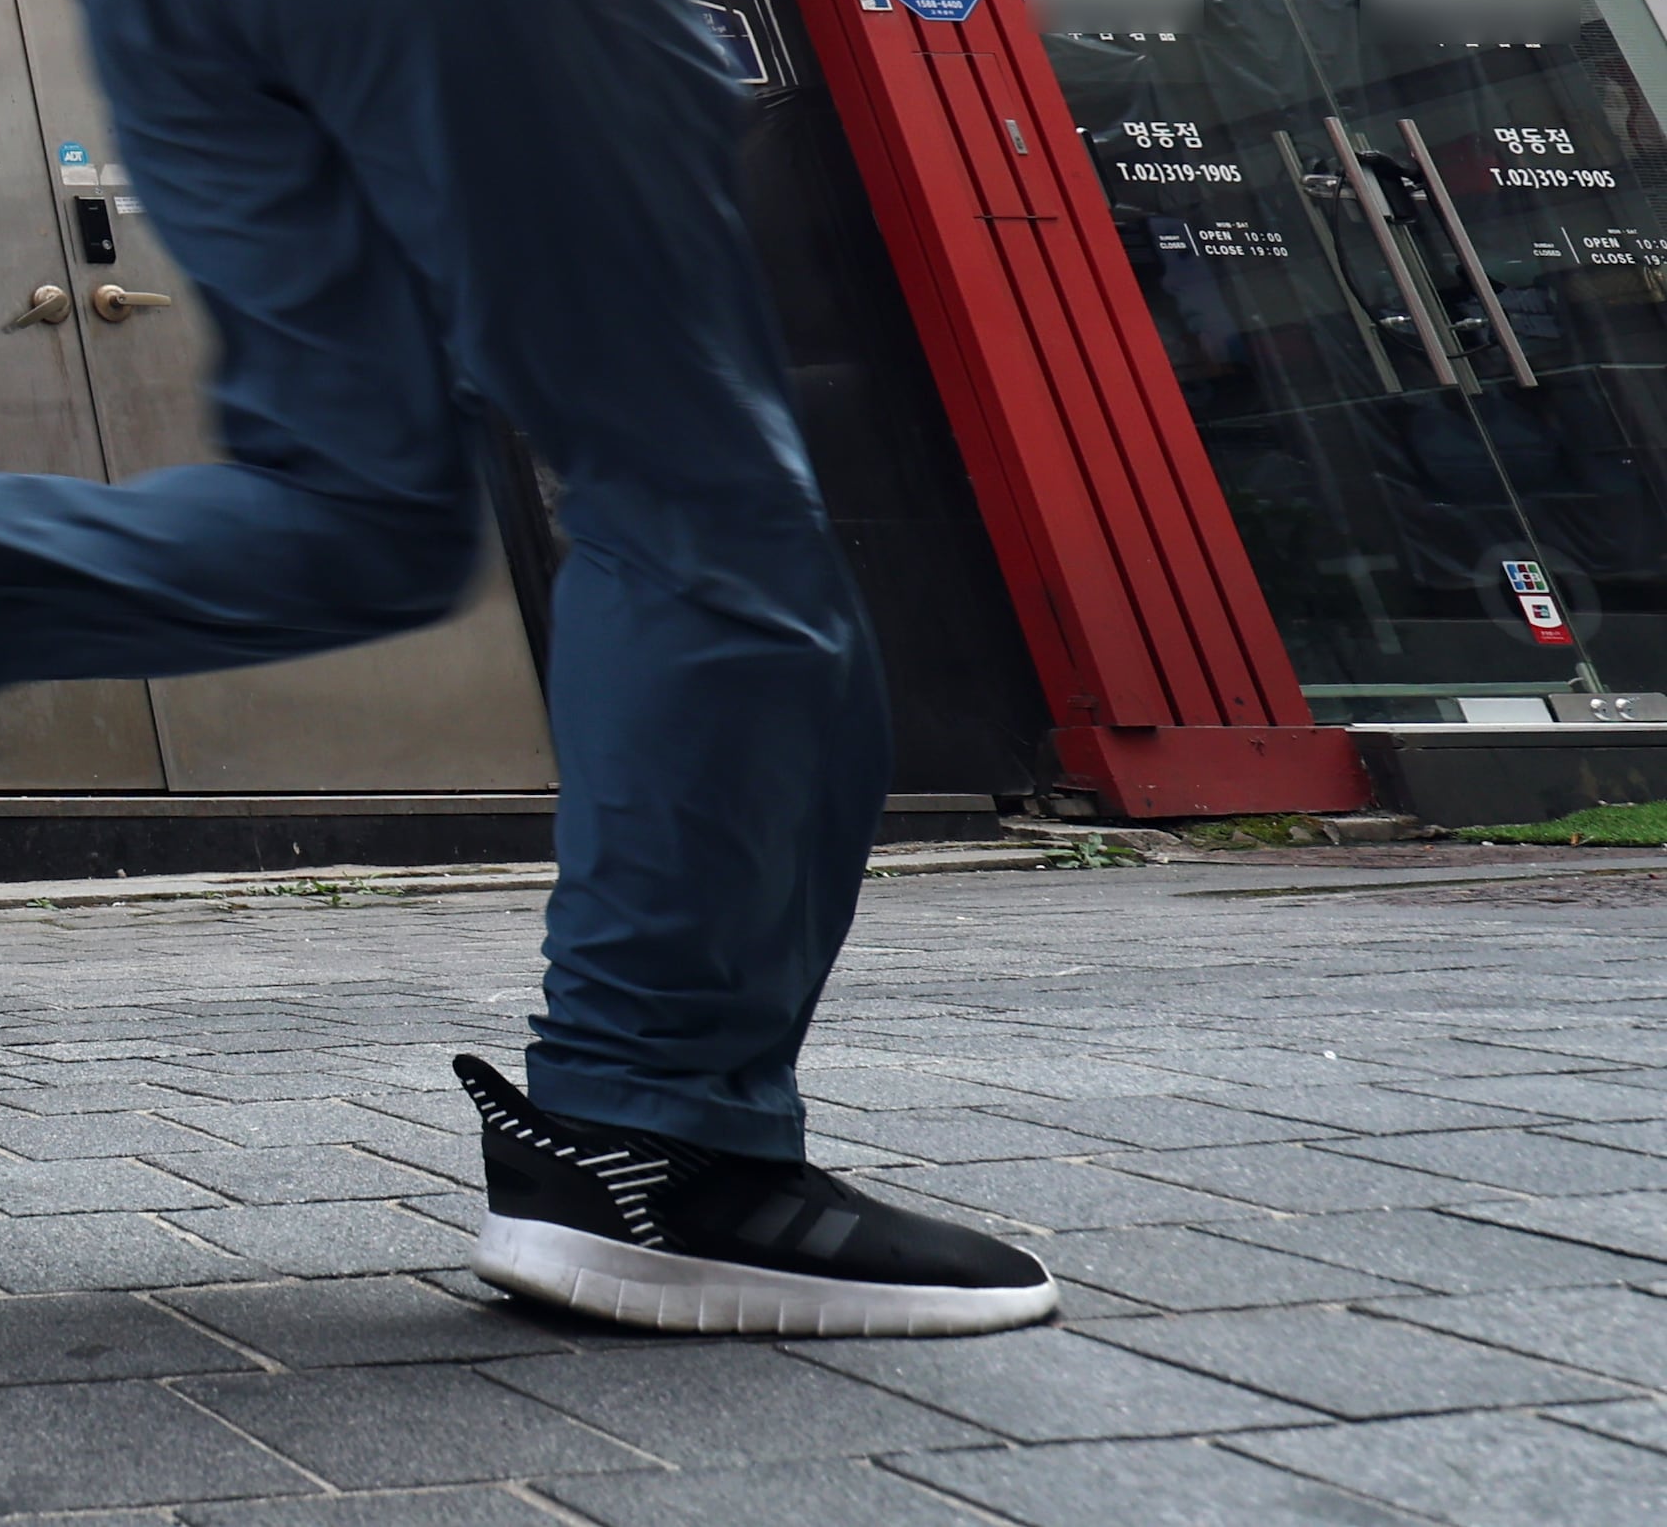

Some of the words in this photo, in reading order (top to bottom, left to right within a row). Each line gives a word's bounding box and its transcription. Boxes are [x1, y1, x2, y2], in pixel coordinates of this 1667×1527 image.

[1123, 122, 1203, 149] 명동점
[1494, 127, 1575, 155] 명동점
[63, 150, 84, 162] ADT
[1116, 162, 1242, 184] T.02)319-1905
[1489, 167, 1617, 190] T.02)319-1905
[1199, 230, 1233, 242] OPEN
[1583, 237, 1620, 249] OPEN
[1204, 244, 1245, 256] CLOSE
[1591, 253, 1636, 265] CLOSE
[1513, 571, 1542, 583] JCB
